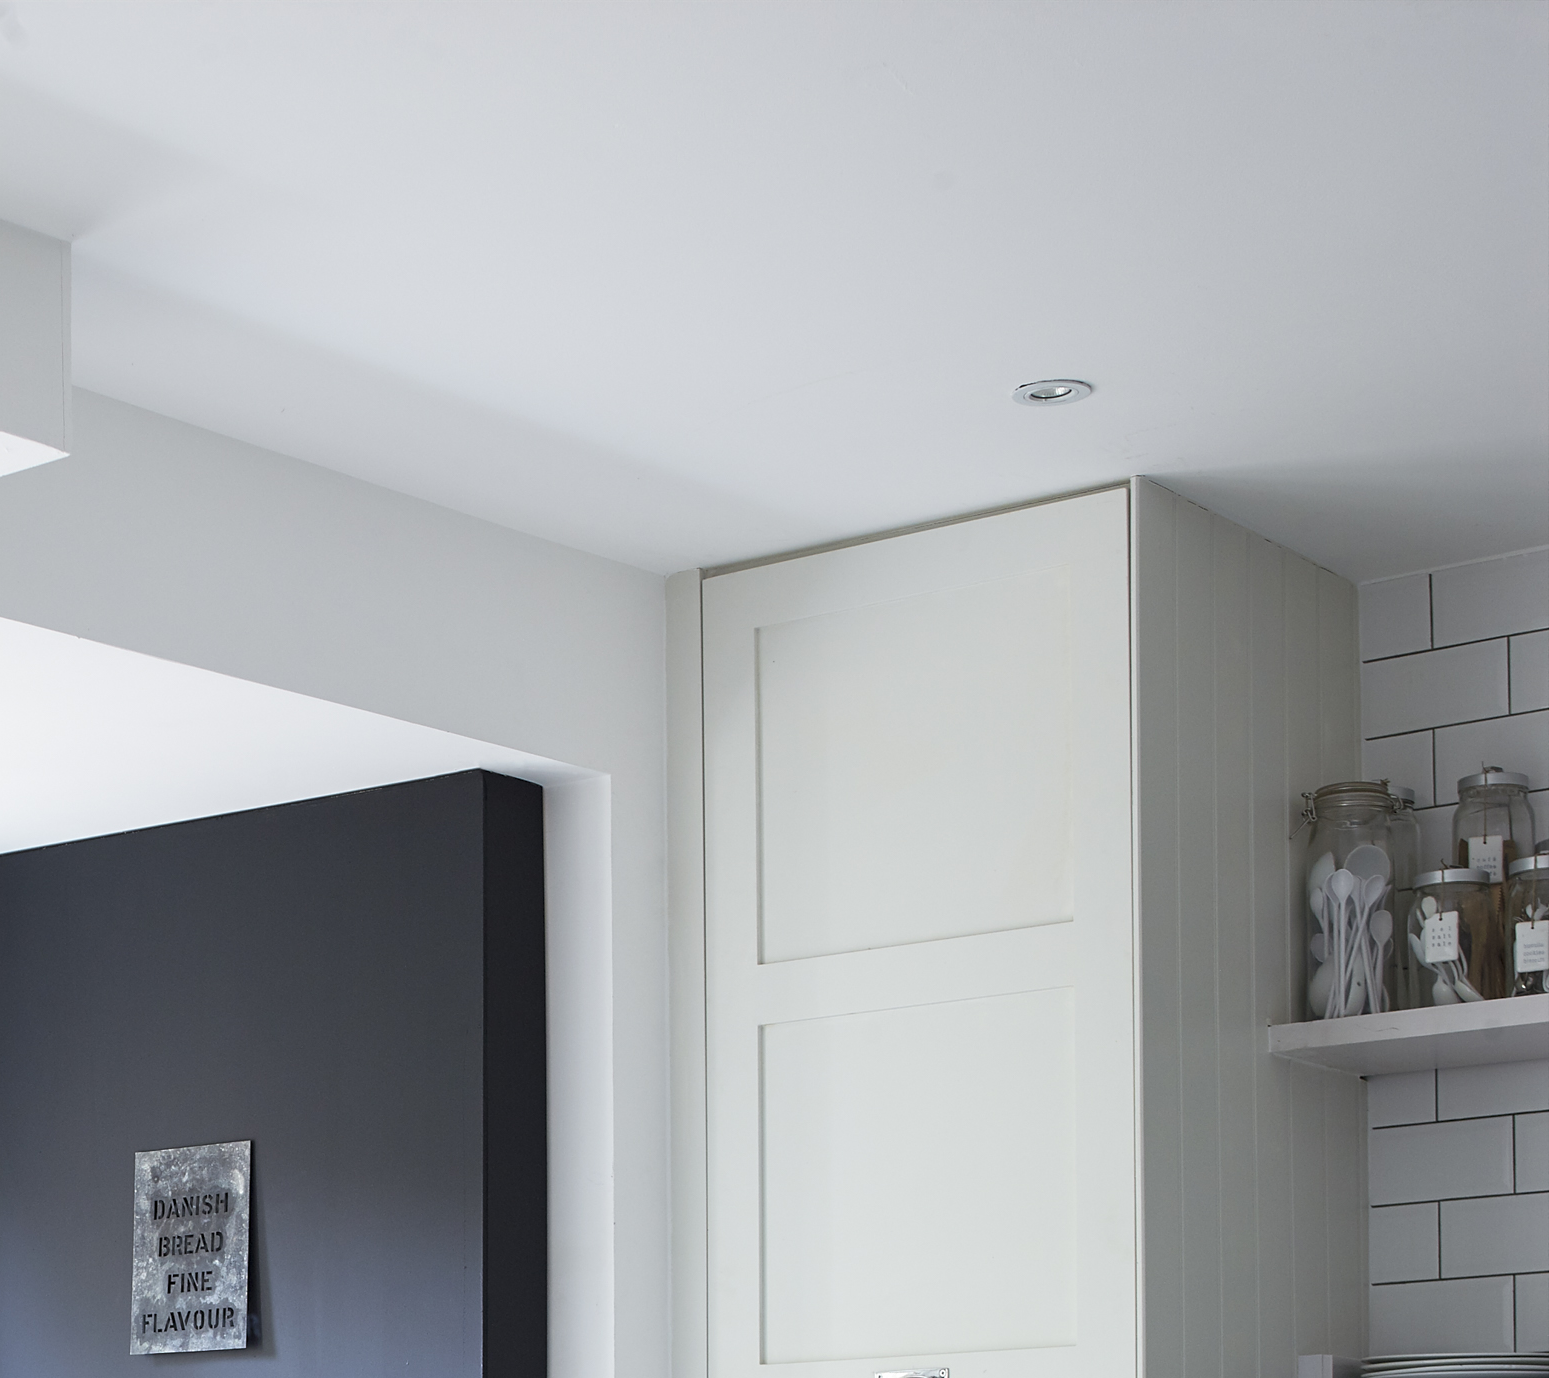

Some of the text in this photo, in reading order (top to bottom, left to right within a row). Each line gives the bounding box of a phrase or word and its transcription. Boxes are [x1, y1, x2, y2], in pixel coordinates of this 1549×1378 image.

[153, 1192, 229, 1220] DANISH
[158, 1231, 224, 1257] BREAD
[167, 1271, 213, 1294] FINE
[141, 1307, 235, 1334] FLAVOUR
